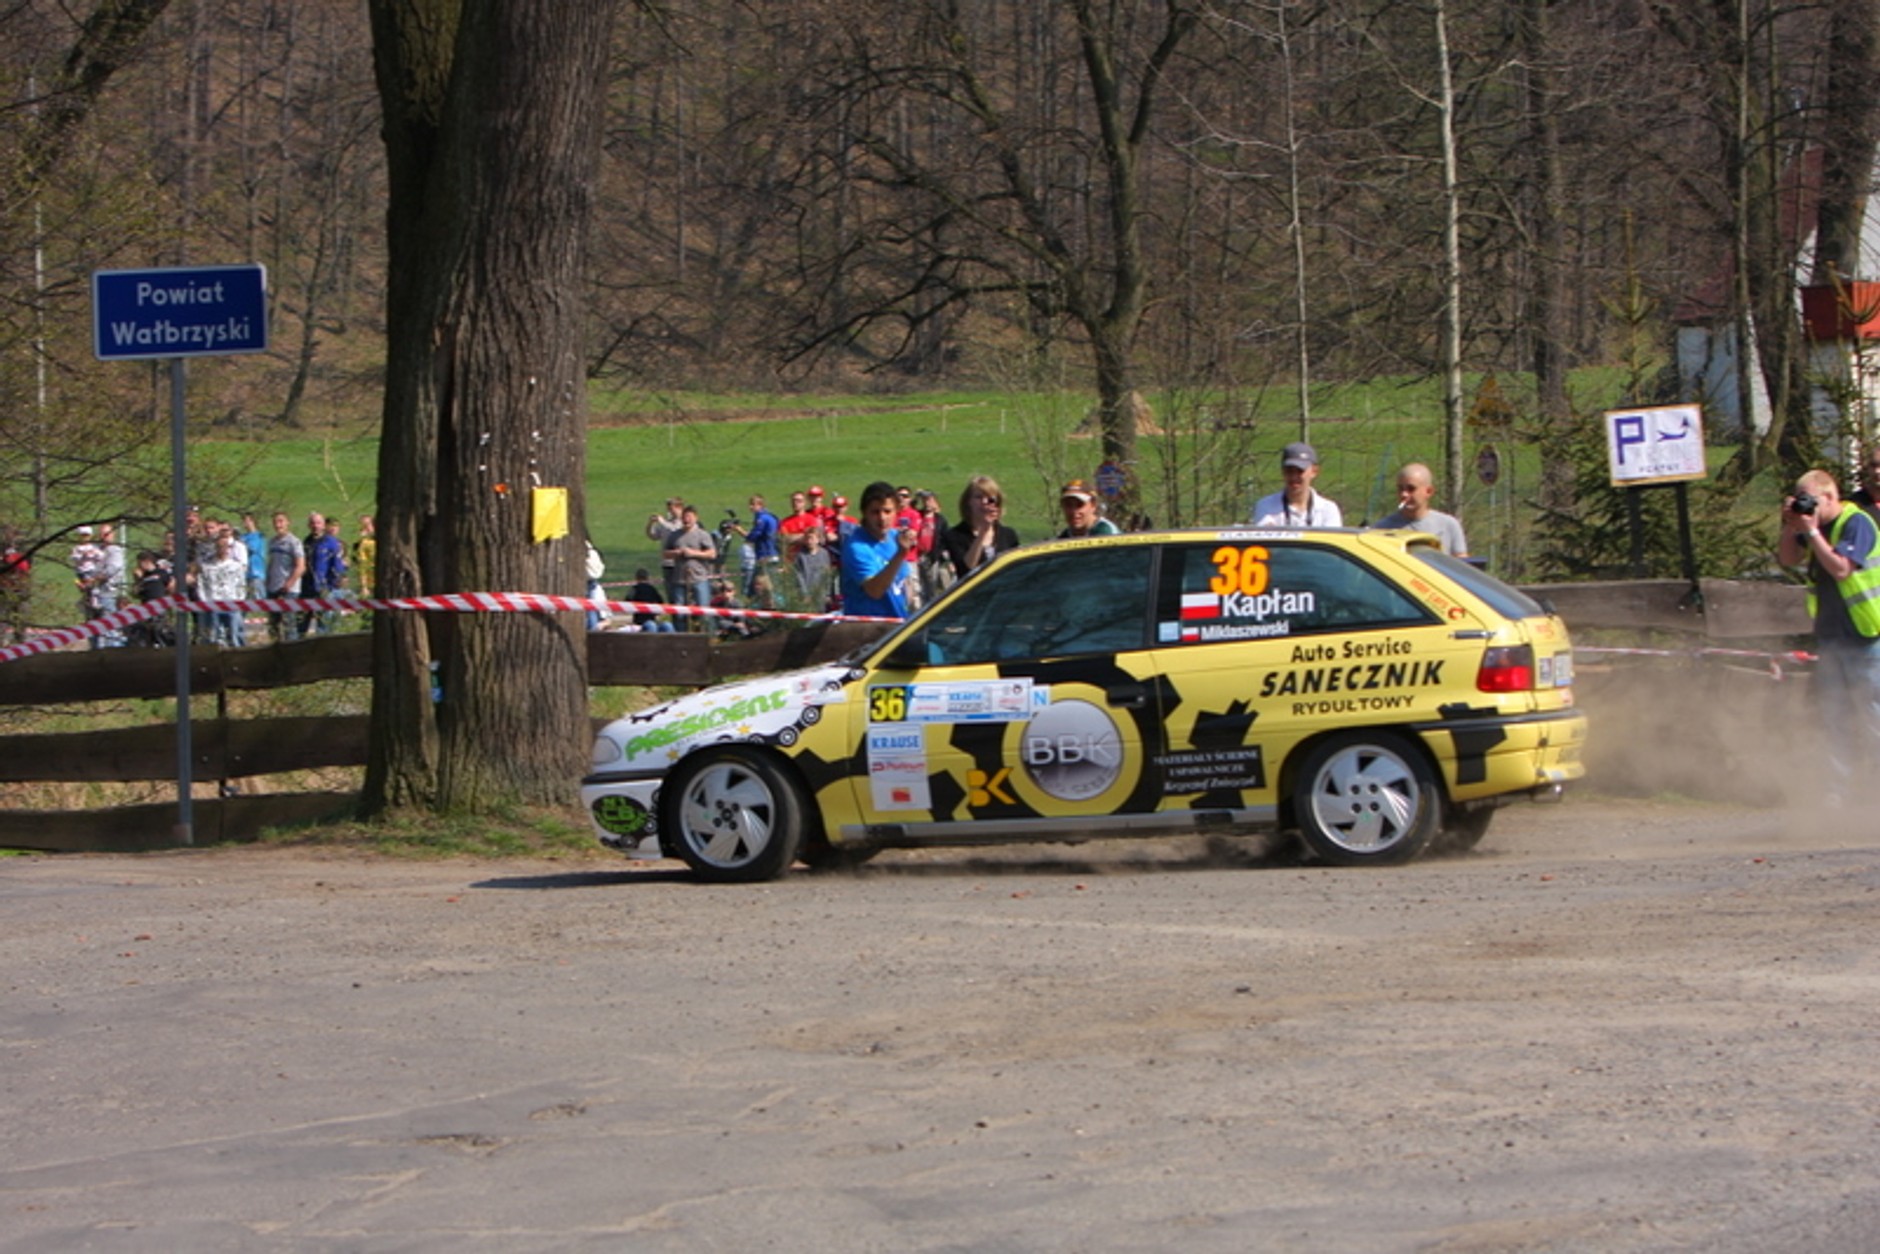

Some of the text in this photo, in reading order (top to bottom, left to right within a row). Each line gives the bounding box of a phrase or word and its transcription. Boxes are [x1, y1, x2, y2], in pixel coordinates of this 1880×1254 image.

[137, 280, 225, 306] Powiat
[111, 317, 250, 349] Wałbrzyski
[1615, 416, 1646, 466] P
[1210, 545, 1271, 597] 36
[1222, 587, 1315, 621] Kapłan
[1291, 637, 1412, 663] Auto Service
[1259, 660, 1446, 697] SANECZNIK
[870, 687, 905, 721] 36
[1034, 691, 1048, 706] N
[1292, 696, 1415, 716] RYDUŁTOWY
[871, 735, 920, 749] KRAUSE
[1027, 730, 1114, 766] BBK
